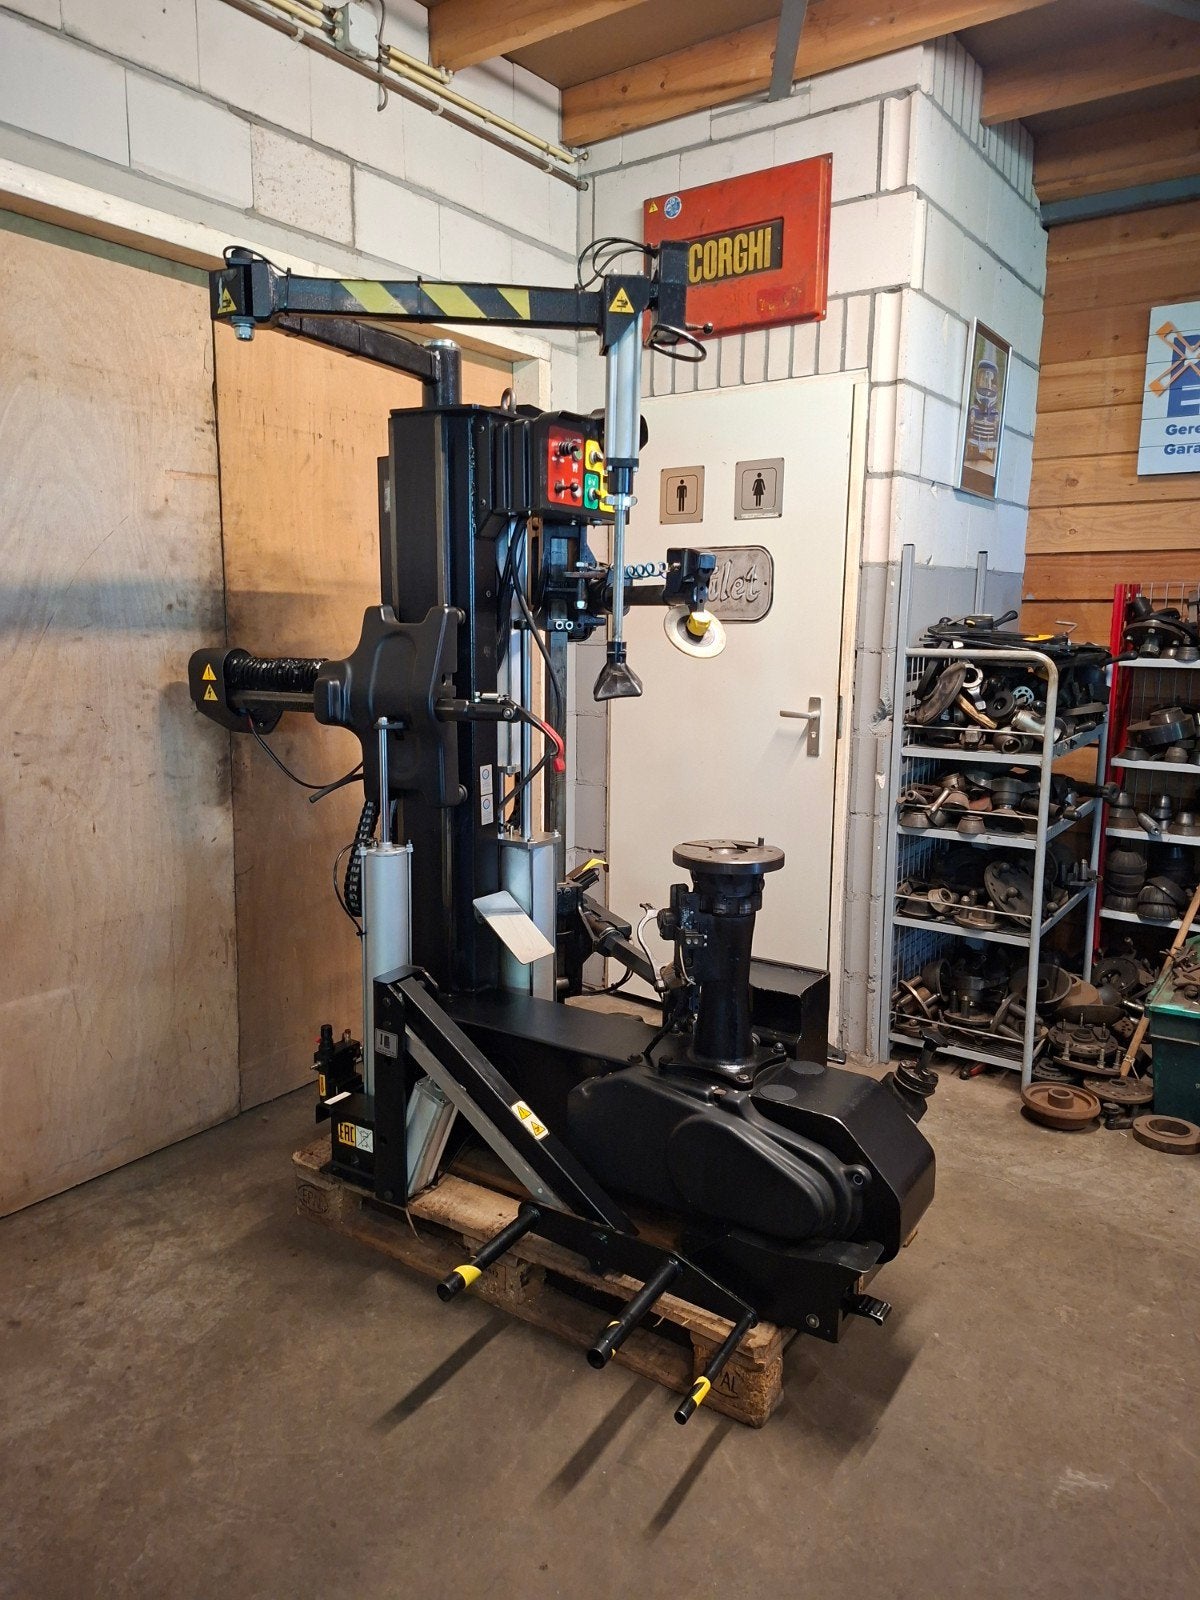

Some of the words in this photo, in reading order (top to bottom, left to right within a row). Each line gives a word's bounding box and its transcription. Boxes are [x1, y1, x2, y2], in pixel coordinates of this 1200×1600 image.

[688, 227, 772, 284] CORGHI
[1165, 424, 1200, 436] Gere
[1163, 443, 1200, 455] Gara
[708, 559, 761, 603] ilet
[339, 1123, 355, 1143] EAC
